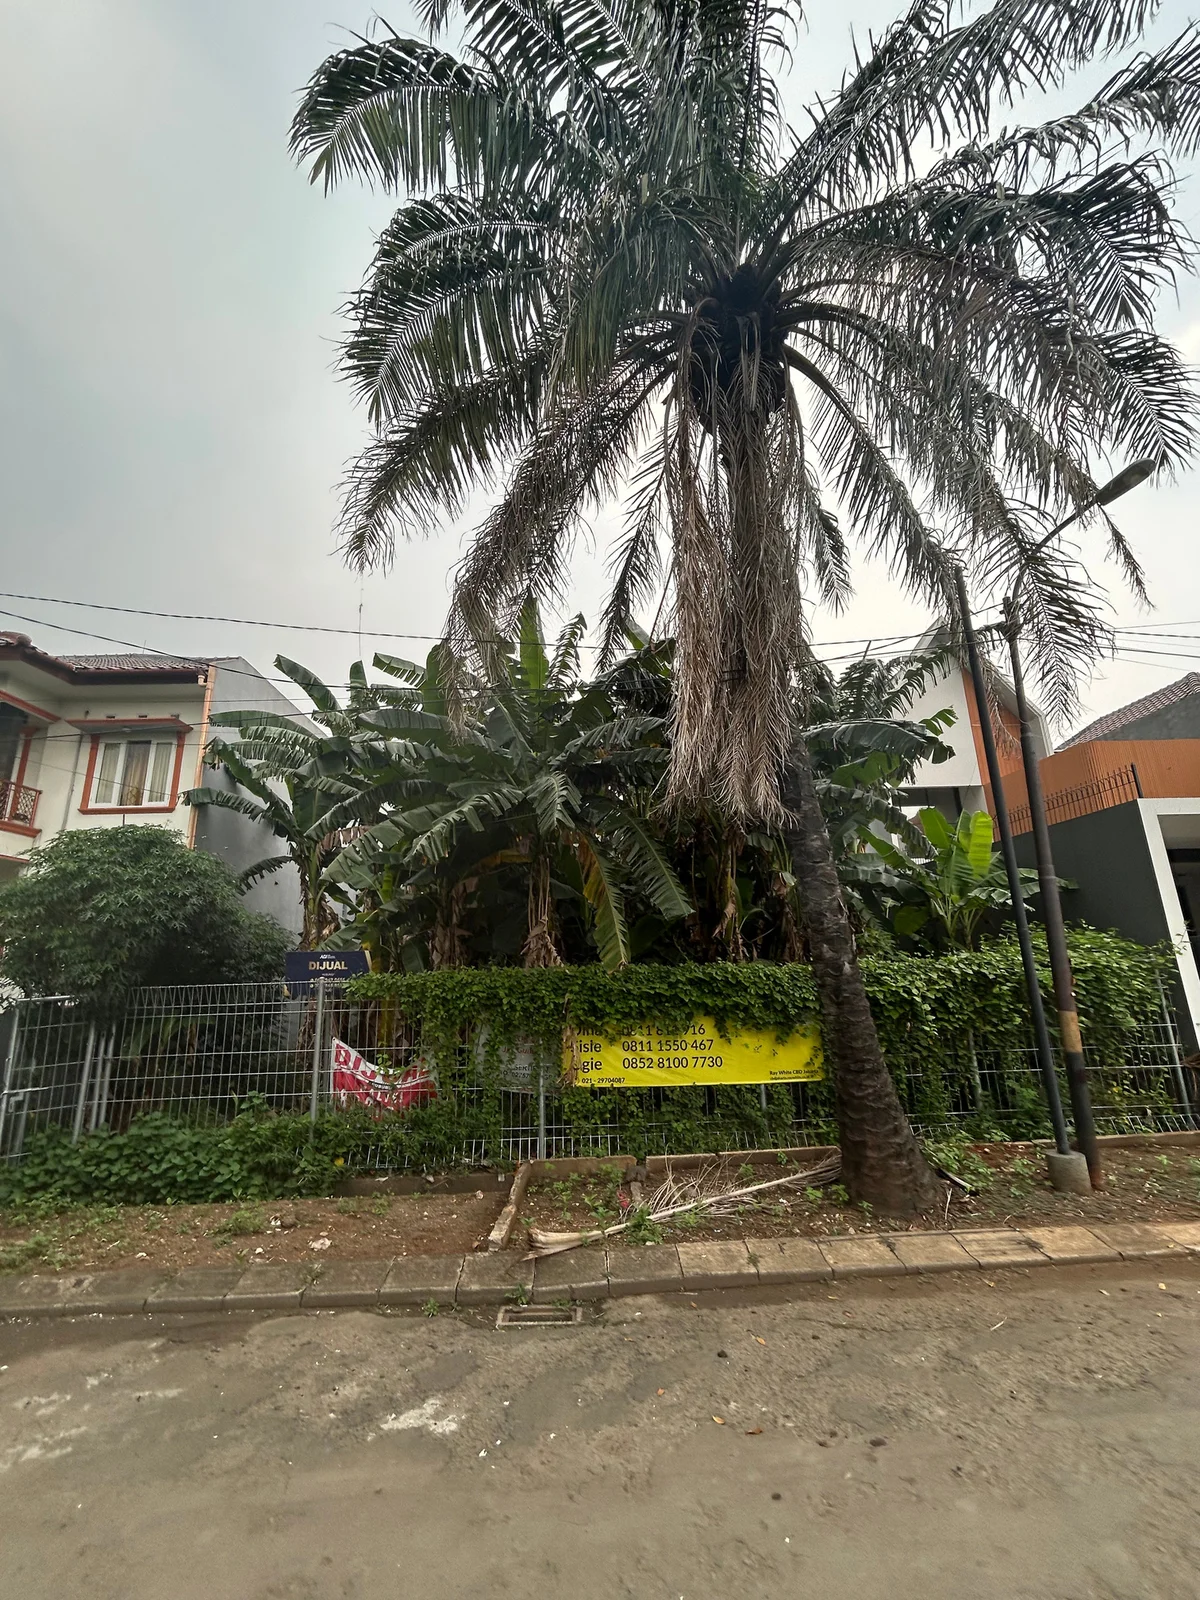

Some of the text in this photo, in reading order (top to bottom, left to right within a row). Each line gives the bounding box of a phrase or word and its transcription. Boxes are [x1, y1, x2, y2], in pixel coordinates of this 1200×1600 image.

[308, 960, 348, 971] DIJUAL
[622, 1040, 653, 1052] 0811
[657, 1040, 688, 1052] 1550
[690, 1039, 714, 1051] 467
[622, 1057, 654, 1069] 0852
[657, 1057, 689, 1069] 8100
[691, 1056, 723, 1068] 7730
